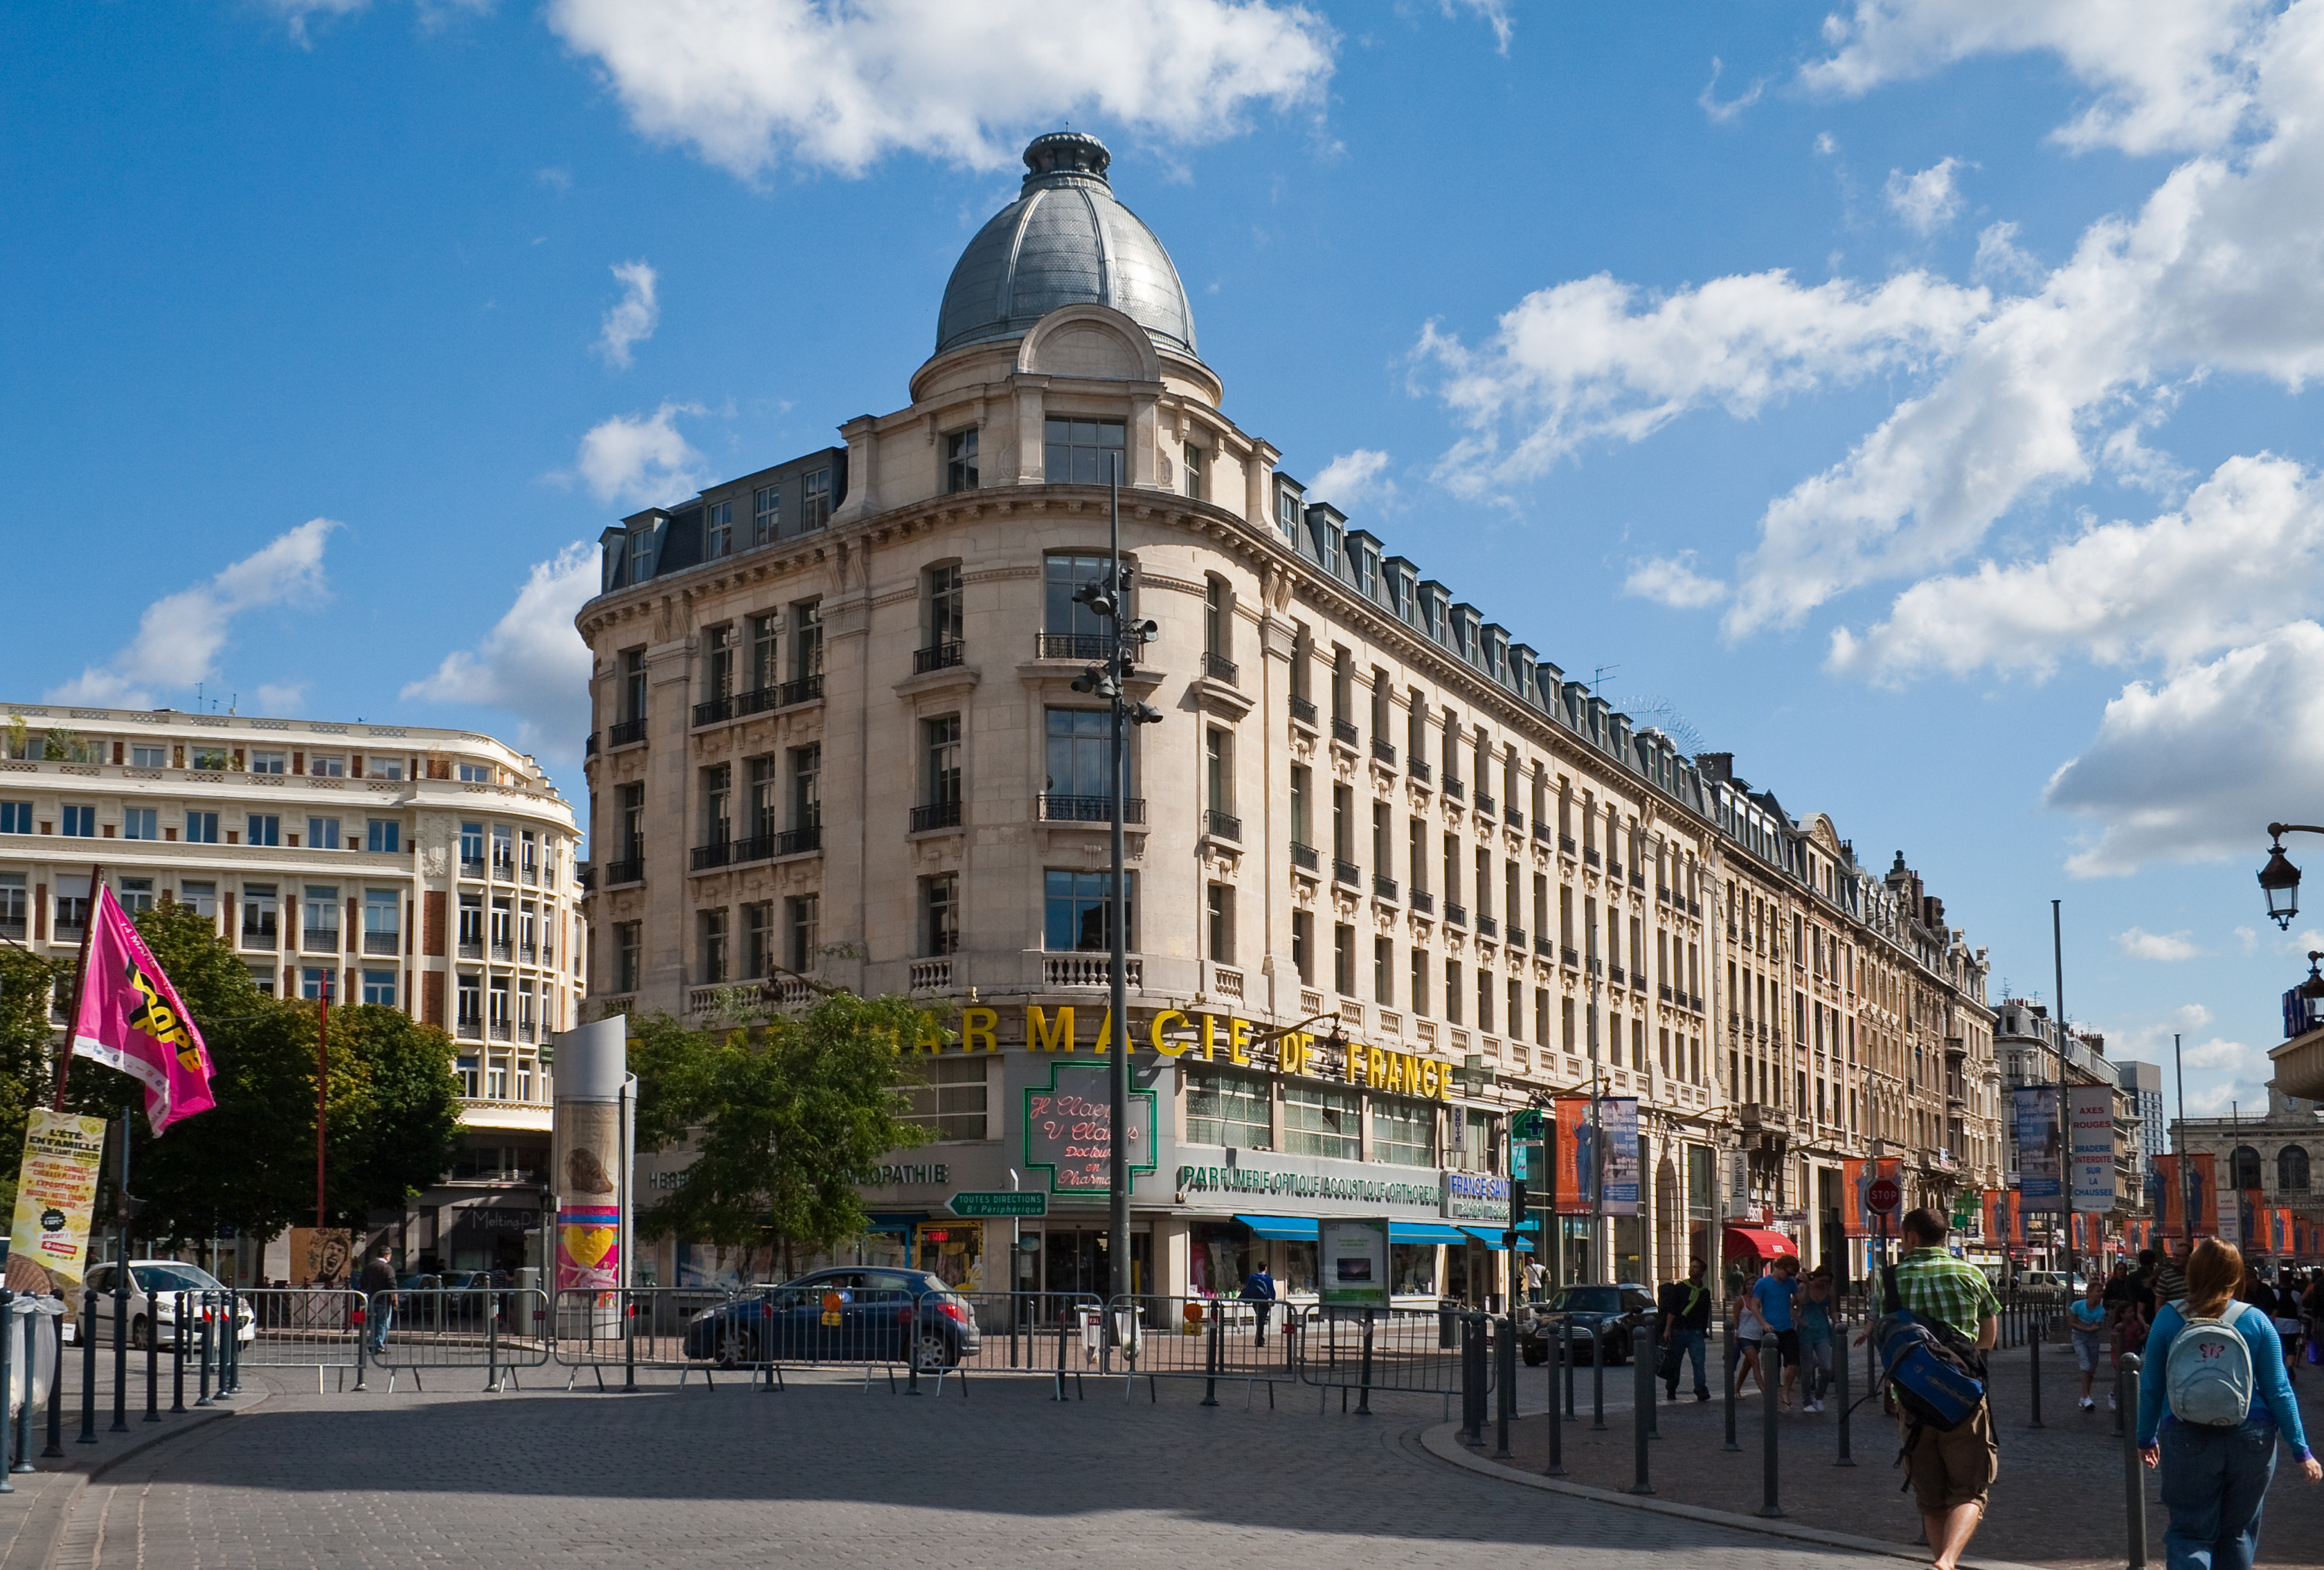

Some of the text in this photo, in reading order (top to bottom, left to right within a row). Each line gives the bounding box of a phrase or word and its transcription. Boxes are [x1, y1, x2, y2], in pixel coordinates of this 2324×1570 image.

[5, 842, 134, 854] RATERNELLE
[231, 851, 381, 865] CAPITALISATION
[897, 1005, 1453, 1101] ARMACIE DE FRANCE
[1057, 1096, 1111, 1124] Clae
[2080, 1106, 2105, 1115] AXES
[2073, 1120, 2111, 1129] ROUGES
[49, 1128, 84, 1140] L'ÉTÉ
[29, 1136, 101, 1152] EN FAMILLE
[2075, 1144, 2111, 1153] BRADERIE
[2075, 1155, 2111, 1164] INTERDITE
[1085, 1163, 1100, 1172] en
[2086, 1166, 2101, 1175] SUR
[1058, 1169, 1111, 1185] Pharma
[1732, 1155, 1745, 1198] Promesse
[36, 1180, 80, 1191] EXPOSITIONS
[1182, 1166, 1443, 1202] PARFUMERIE OPTIQUE ACOUSTIQUE ORTHOPEDIE
[1451, 1175, 1511, 1198] FRANCE SANT
[1871, 1191, 1897, 1200] STOP
[2074, 1189, 2114, 1197] CHAUSSEE
[959, 1195, 1043, 1204] TOUTES DIRECTIONS
[966, 1204, 1043, 1215] Bd Périphérique
[473, 1211, 519, 1230] Melting
